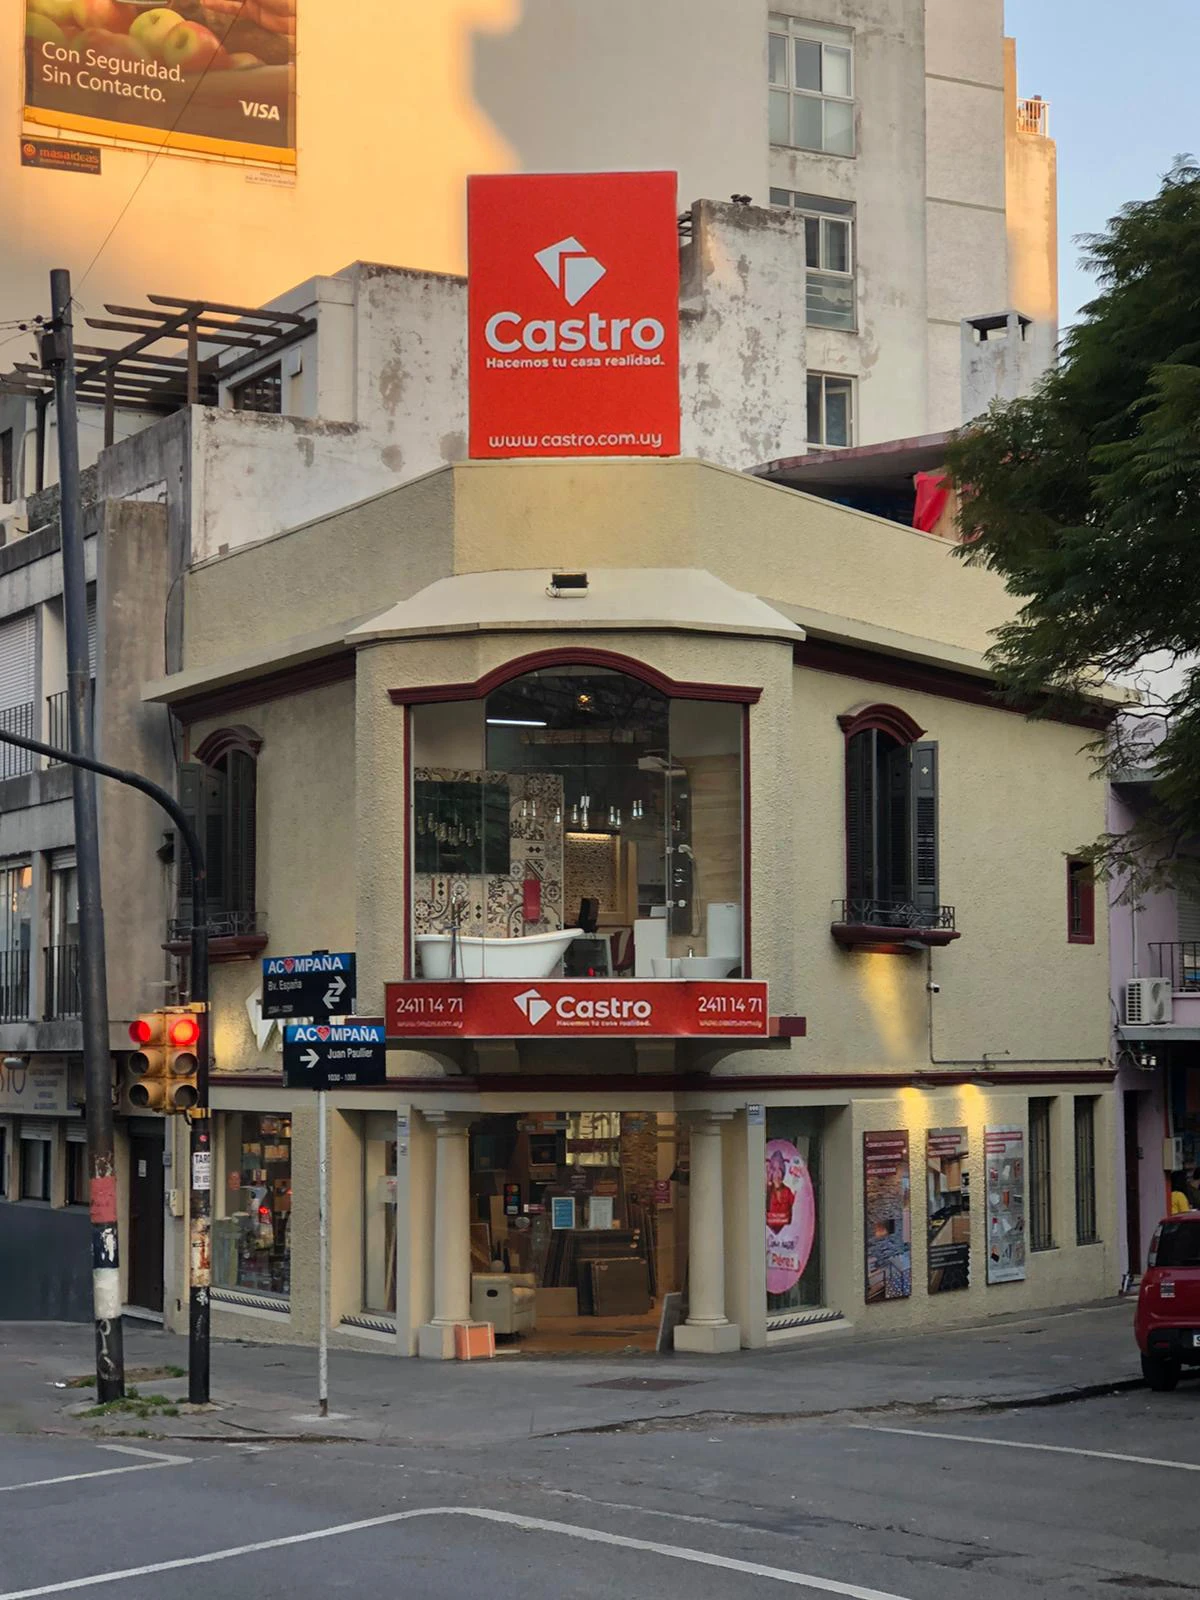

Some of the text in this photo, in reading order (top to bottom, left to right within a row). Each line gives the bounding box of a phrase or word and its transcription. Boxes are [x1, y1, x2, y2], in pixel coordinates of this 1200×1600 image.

[42, 41, 186, 83] Con Seguridad.
[42, 64, 167, 103] Sin Contacto.
[239, 100, 280, 121] VISA
[485, 311, 666, 353] Castro
[486, 353, 666, 369] Hacemos tu casa realidad.
[488, 432, 663, 449] www.castro.com.uy
[396, 998, 464, 1013] 2411 14 71
[555, 996, 652, 1018] Castro
[698, 996, 763, 1013] 2411 14 71
[327, 1048, 346, 1060] Juan
